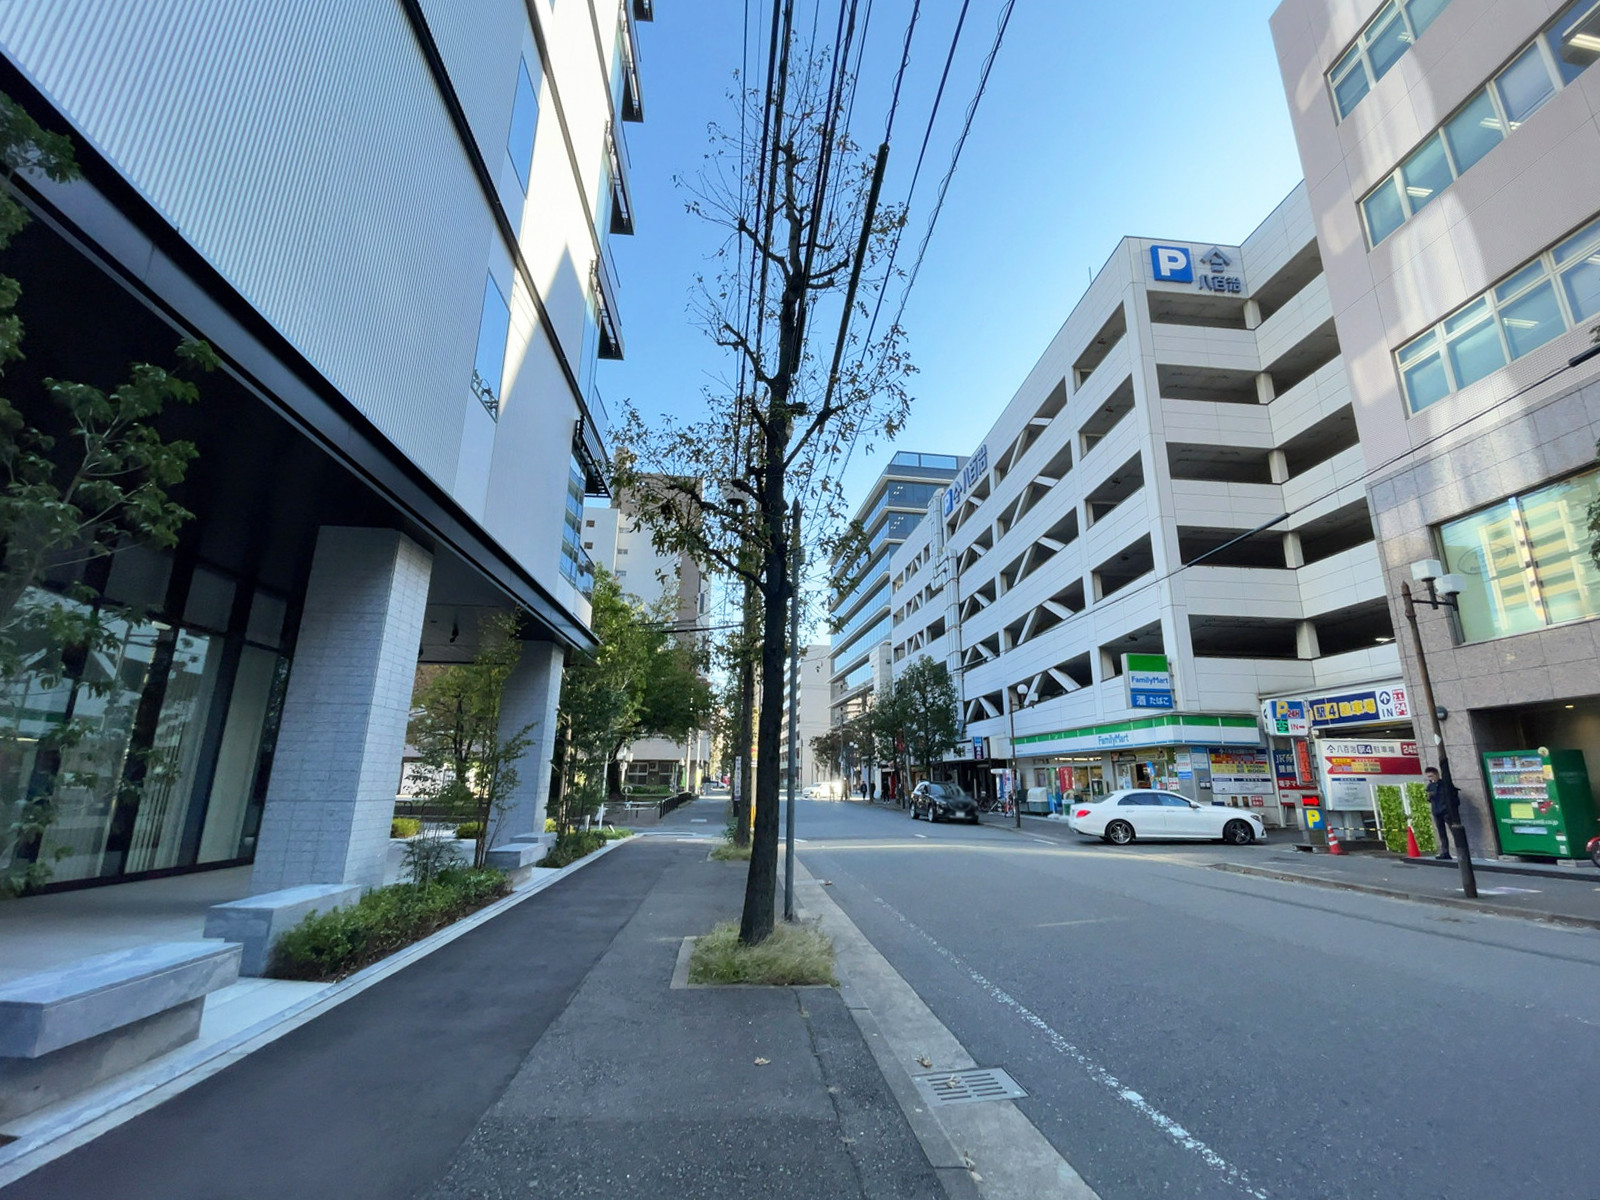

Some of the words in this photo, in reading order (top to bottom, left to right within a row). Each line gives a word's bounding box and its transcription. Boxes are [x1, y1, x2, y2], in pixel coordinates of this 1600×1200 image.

[1157, 248, 1187, 276] P
[1131, 676, 1168, 685] FamilyMart
[1136, 695, 1146, 706] 酒
[1149, 696, 1170, 706] たばこ
[1277, 701, 1288, 717] P
[1381, 707, 1393, 717] IN
[1098, 733, 1129, 746] FamilyMart
[1306, 810, 1321, 828] P
